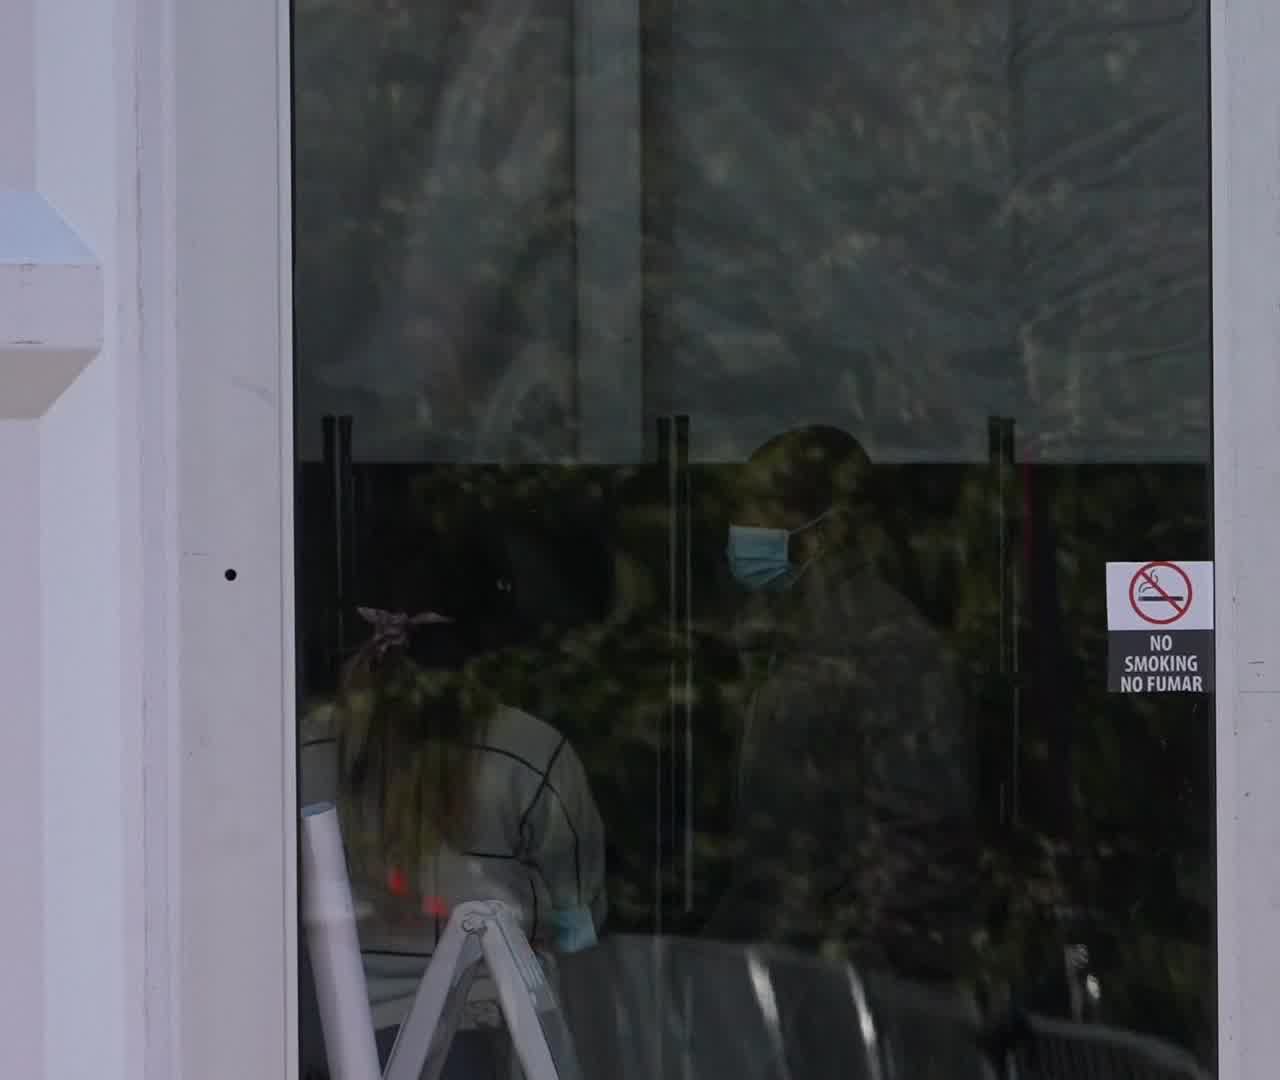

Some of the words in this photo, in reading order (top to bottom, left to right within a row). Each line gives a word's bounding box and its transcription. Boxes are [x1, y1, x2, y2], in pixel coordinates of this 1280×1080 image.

[1150, 634, 1172, 651] NO
[1124, 655, 1198, 672] SMOKING
[1120, 675, 1143, 693] NO
[1147, 675, 1203, 693] FUMAR
